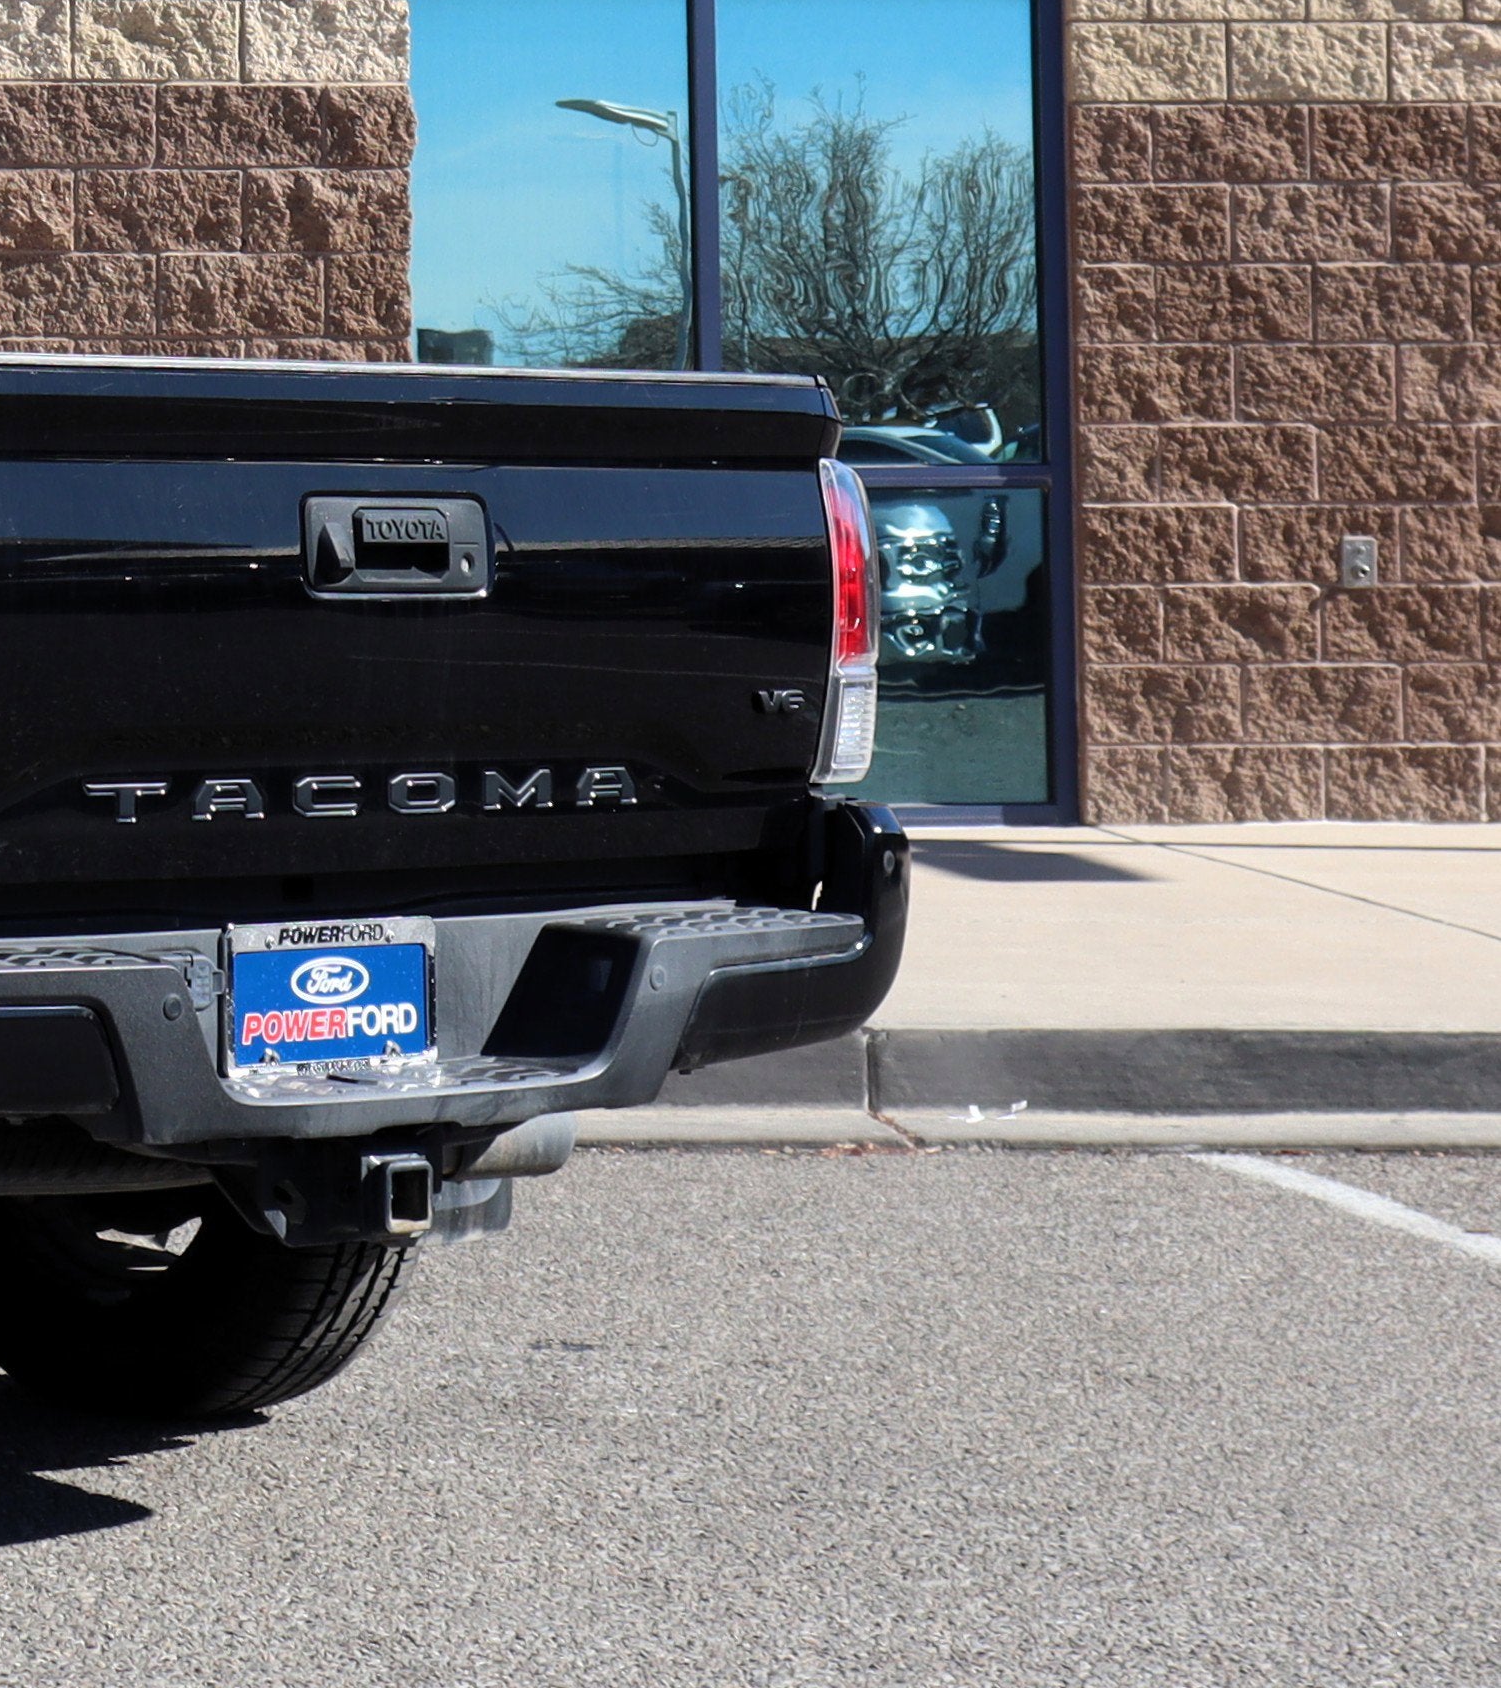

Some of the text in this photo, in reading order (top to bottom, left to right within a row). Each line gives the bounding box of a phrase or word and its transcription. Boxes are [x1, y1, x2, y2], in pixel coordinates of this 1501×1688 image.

[366, 518, 445, 540] TOYOTA
[756, 688, 805, 713] V6
[83, 766, 638, 825] TACOMA
[306, 965, 353, 994] Ford
